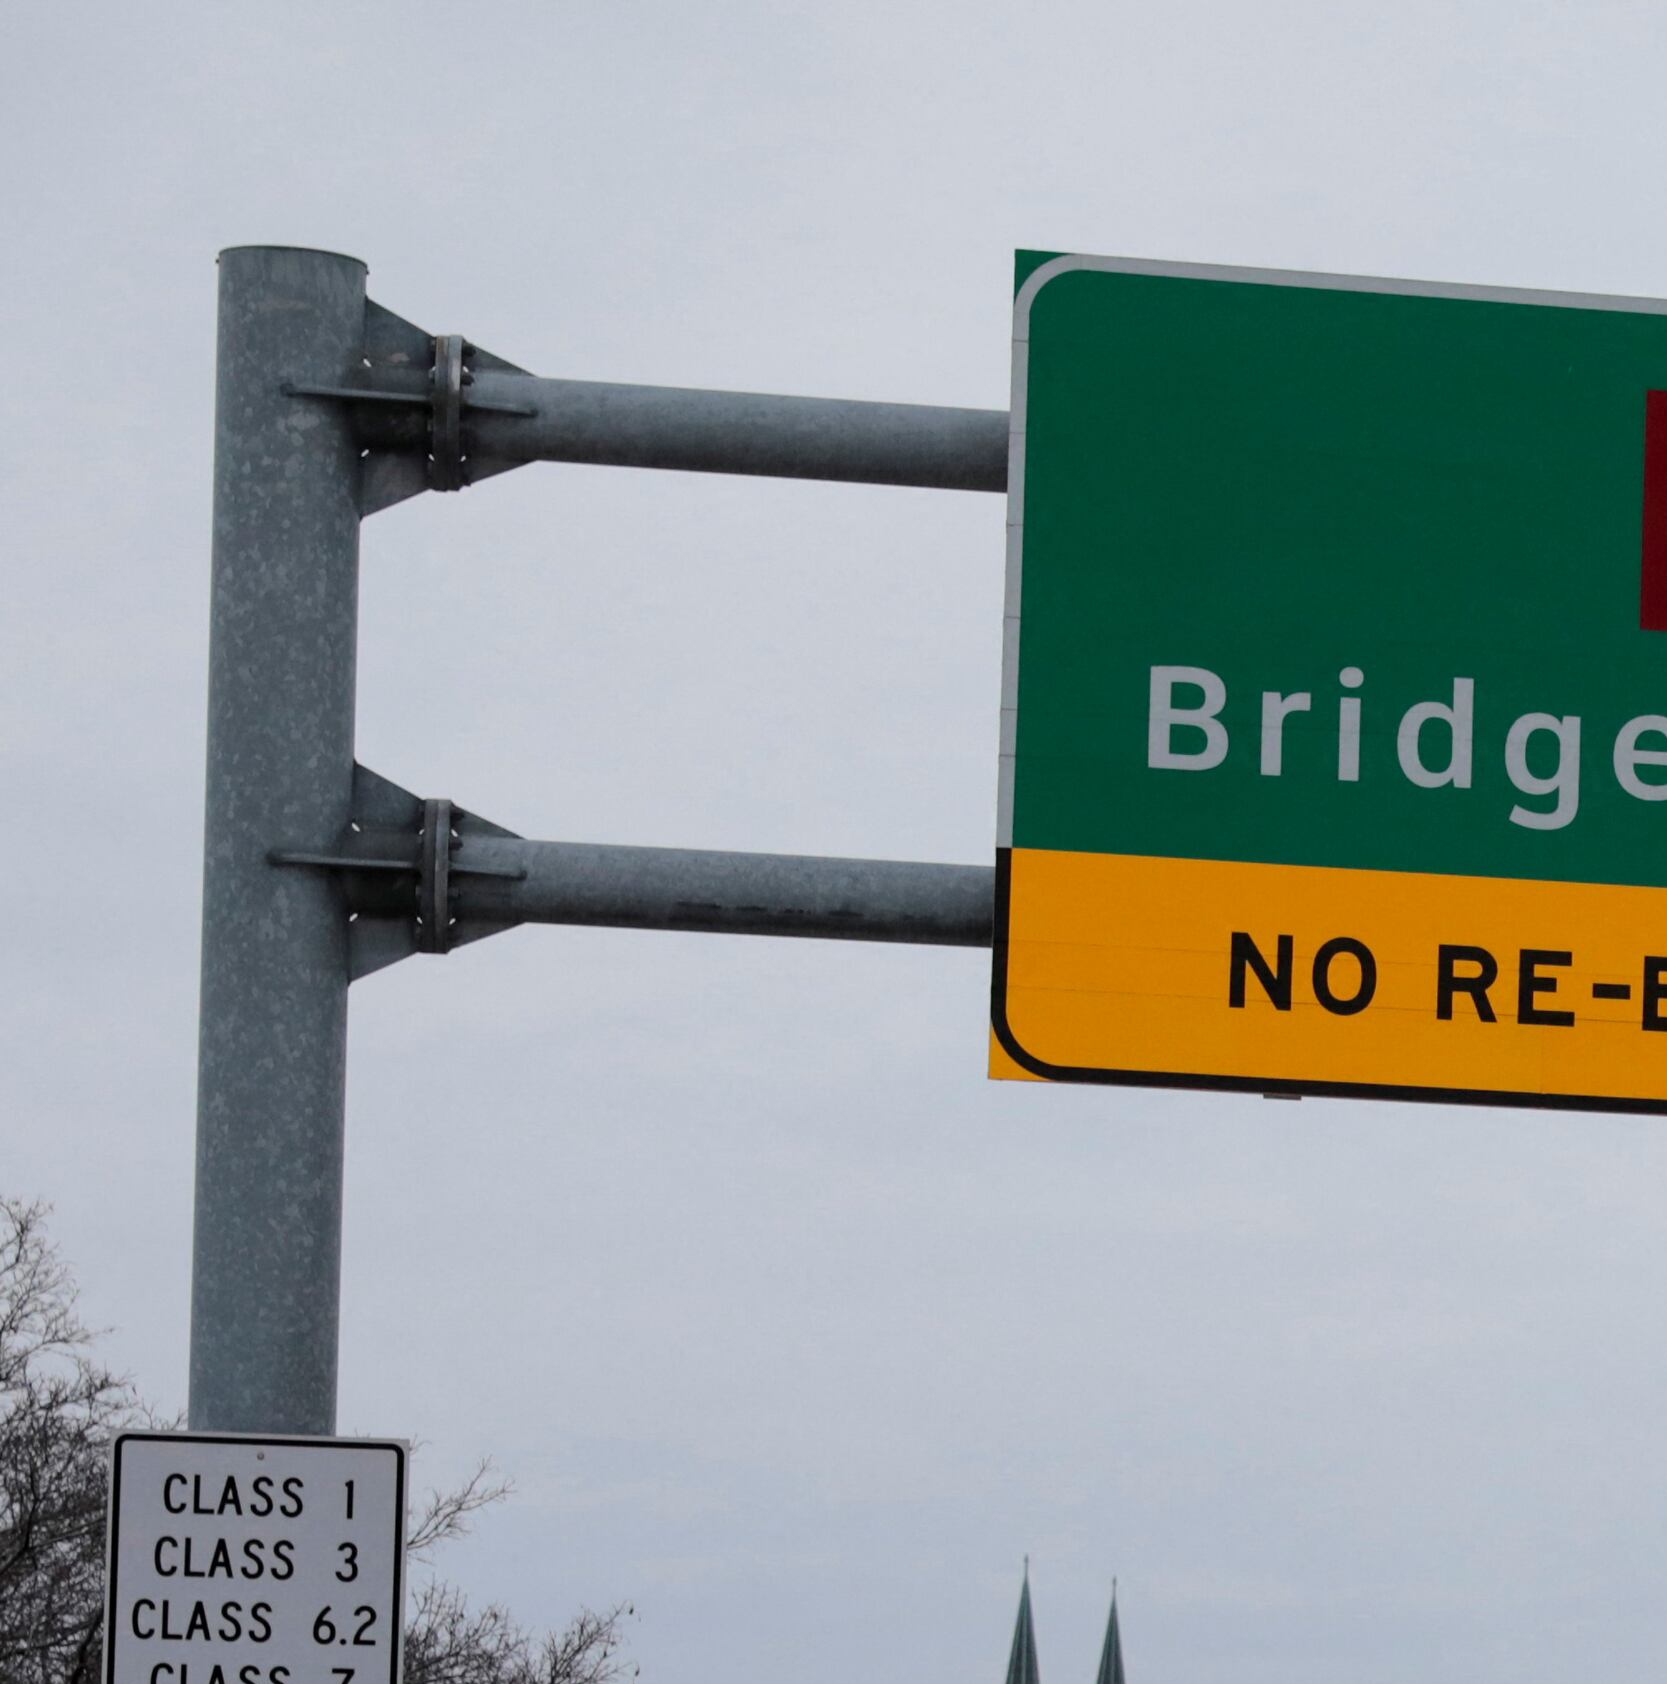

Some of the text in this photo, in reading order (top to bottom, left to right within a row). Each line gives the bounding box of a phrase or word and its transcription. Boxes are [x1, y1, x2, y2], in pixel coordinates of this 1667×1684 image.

[1227, 930, 1378, 1018] NO
[163, 1472, 355, 1520] CLASS 1
[154, 1535, 359, 1583] CLASS 3
[131, 1598, 377, 1646] CLASS 6.2
